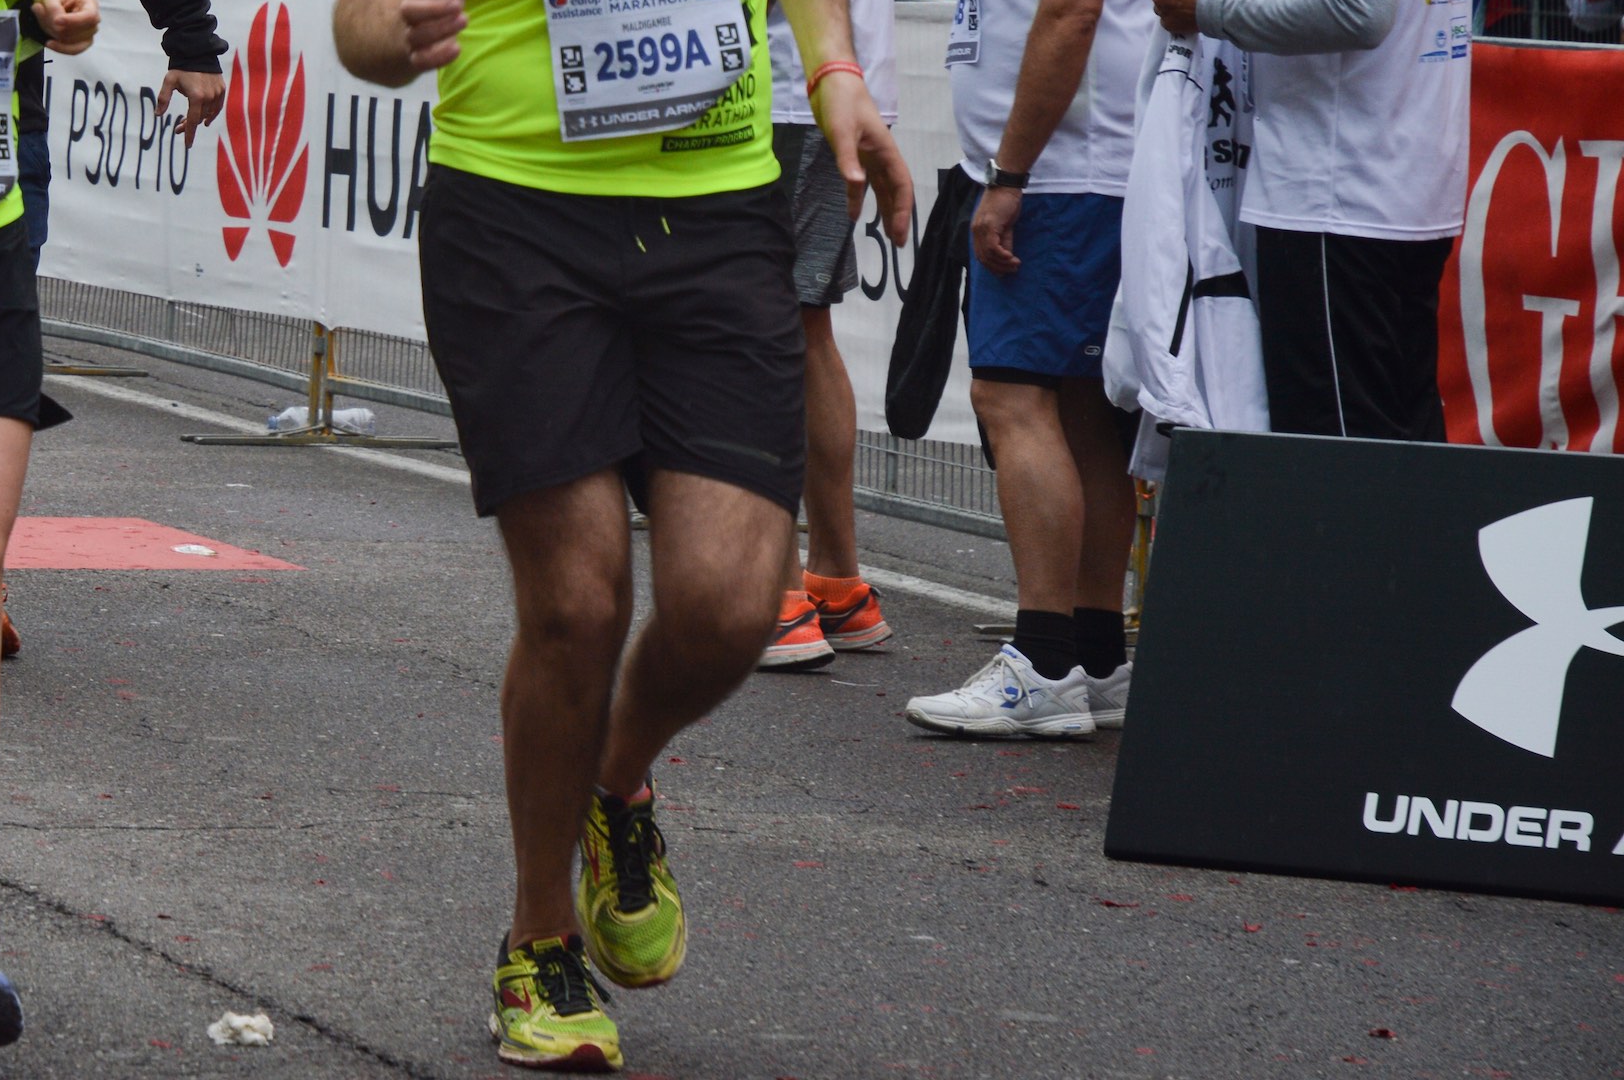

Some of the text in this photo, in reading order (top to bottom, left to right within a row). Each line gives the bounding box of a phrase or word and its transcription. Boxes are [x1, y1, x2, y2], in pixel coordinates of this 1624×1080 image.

[551, 7, 602, 20] assistance
[593, 28, 712, 82] 2599A
[67, 79, 190, 196] P30 Pro
[601, 108, 661, 126] UNDER
[322, 92, 431, 239] HUA
[1362, 790, 1595, 853] UNDER
